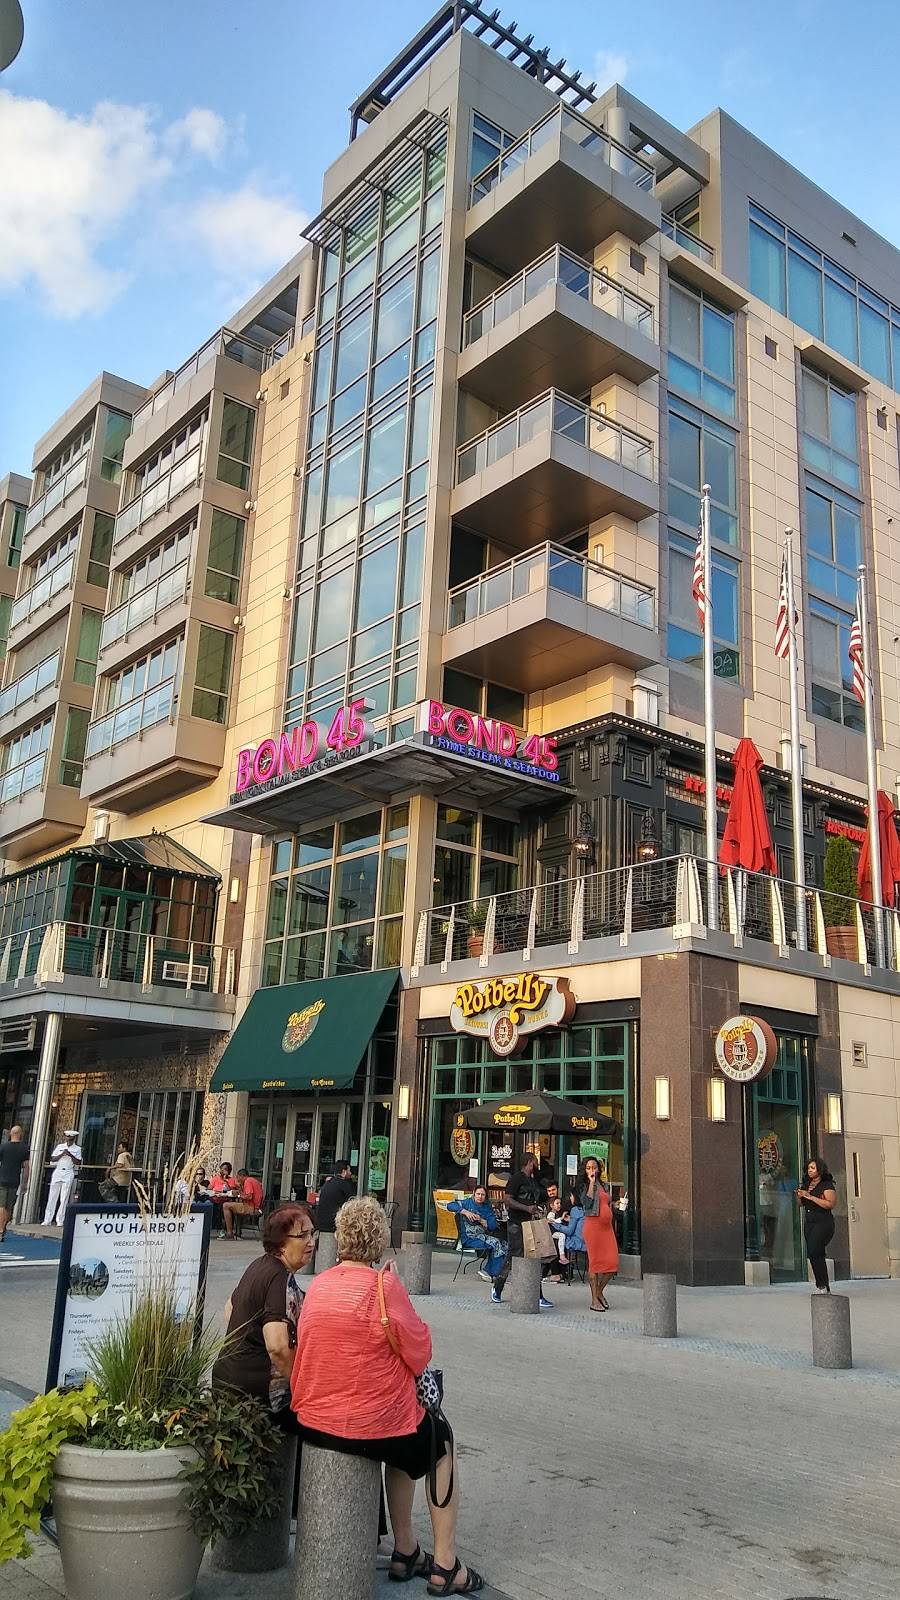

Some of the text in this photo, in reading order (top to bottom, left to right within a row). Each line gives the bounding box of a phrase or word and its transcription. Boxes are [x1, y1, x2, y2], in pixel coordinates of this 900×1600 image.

[236, 698, 368, 792] BOND 45
[428, 700, 559, 771] BOND 45
[514, 760, 560, 782] SEAFOOD
[454, 973, 547, 1024] Potbelly
[287, 999, 326, 1027] Potbelly
[720, 1019, 755, 1041] Potbelly
[493, 1113, 526, 1127] Potbelly
[572, 1117, 598, 1130] Potbelly
[94, 1222, 185, 1234] YOU HARBOR
